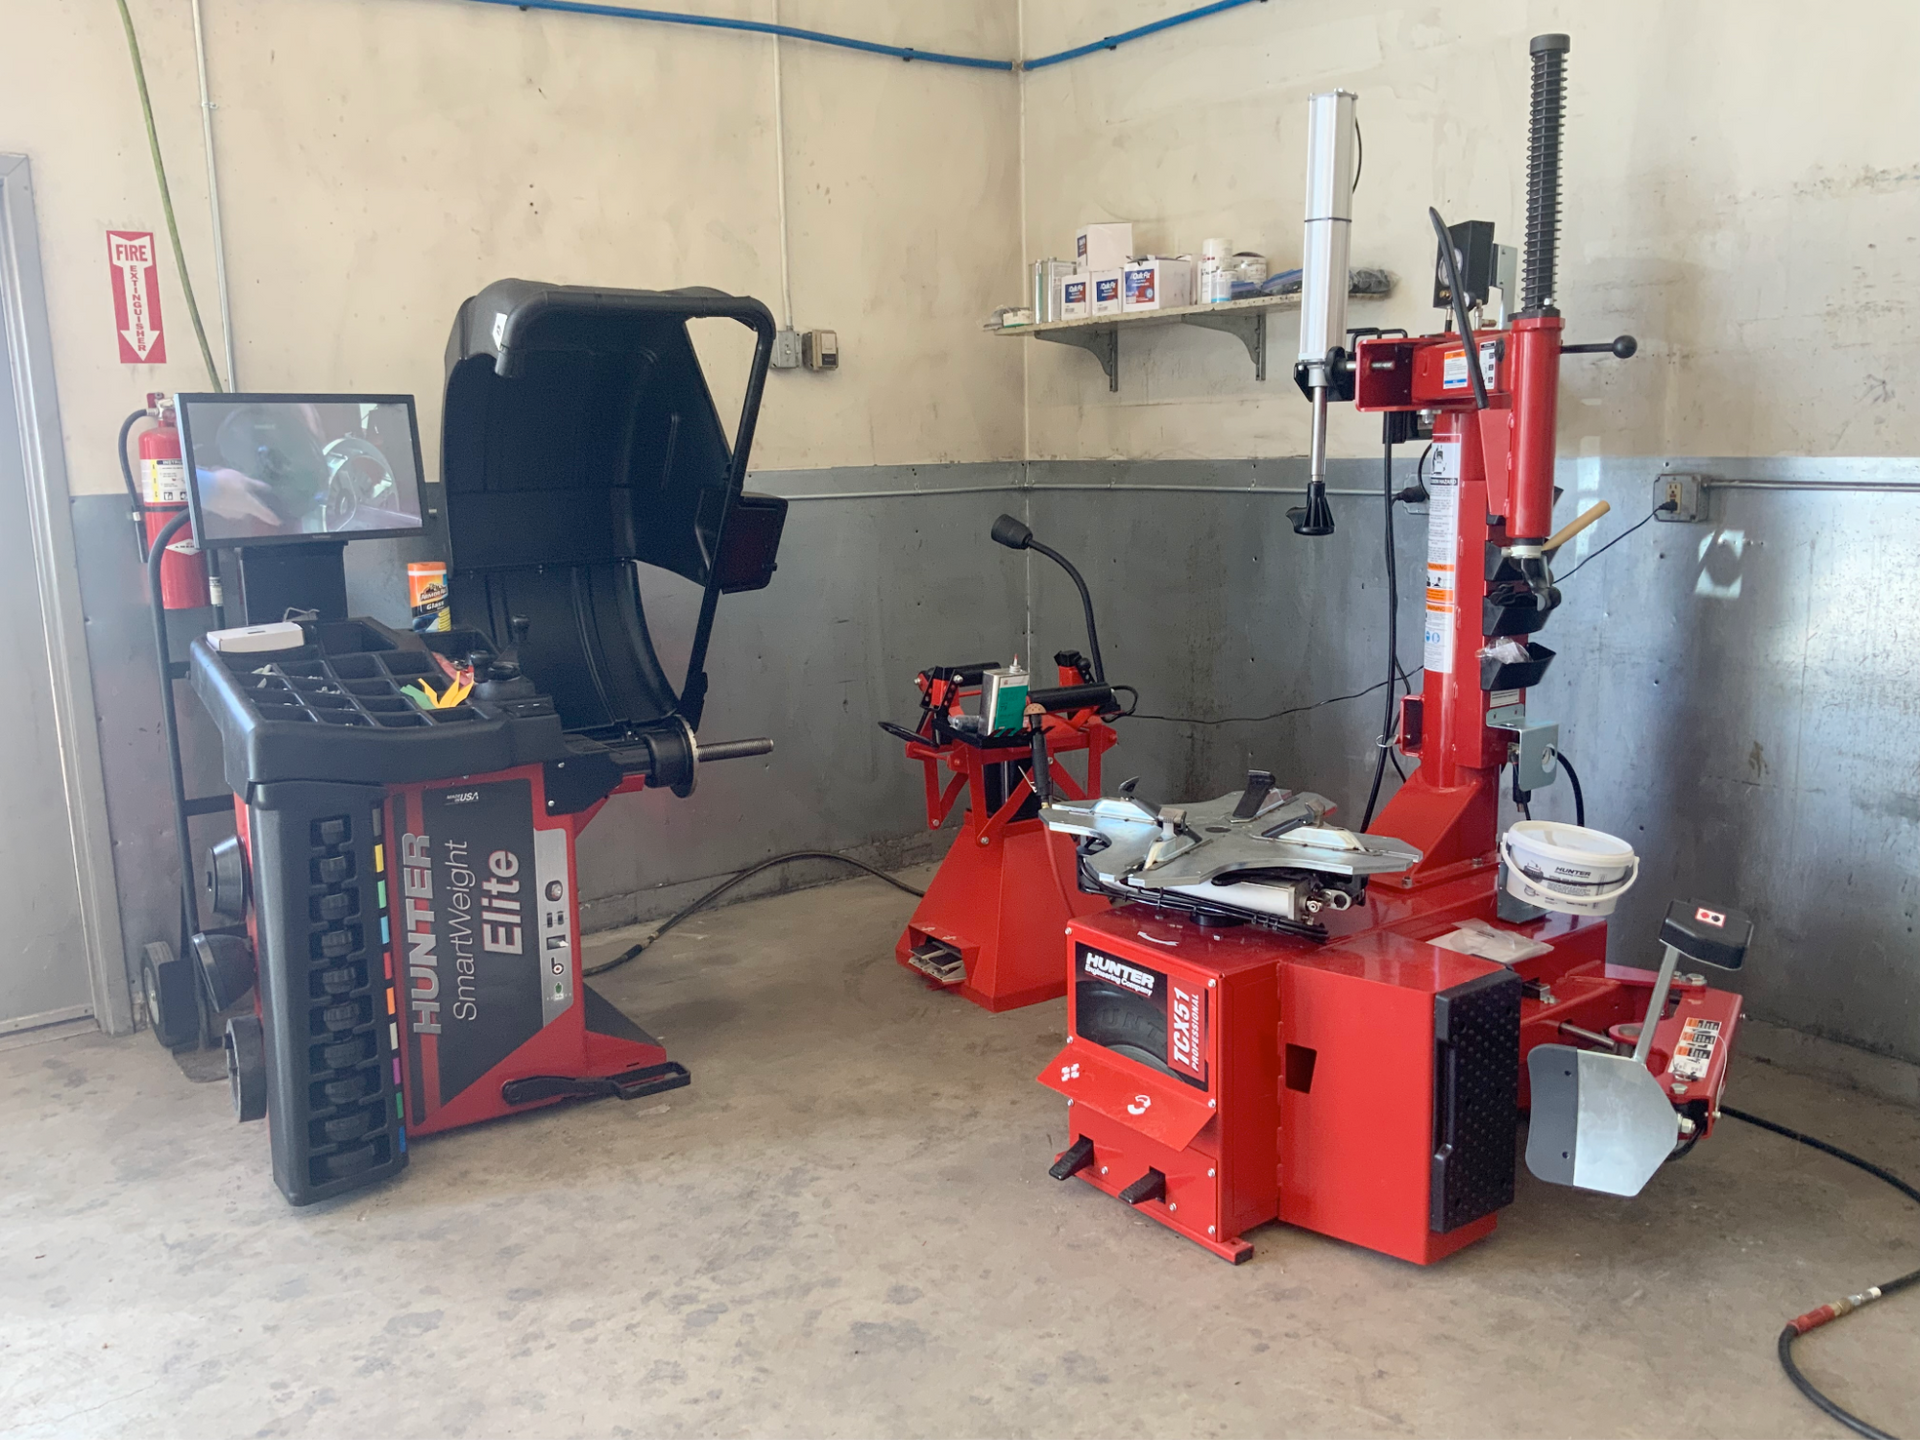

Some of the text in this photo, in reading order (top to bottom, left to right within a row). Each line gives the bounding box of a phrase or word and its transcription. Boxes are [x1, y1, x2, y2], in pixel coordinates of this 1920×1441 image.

[115, 243, 148, 262] FIRE
[129, 265, 147, 351] EXTINGUISHER
[460, 791, 479, 802] USA
[481, 850, 523, 955] Elite
[1555, 866, 1591, 877] HUNTER
[402, 833, 442, 1034] HUNTER
[444, 840, 477, 1020] SmartWeight
[1085, 963, 1153, 996] Engineering Company
[1086, 952, 1155, 989] HUNTER
[1173, 986, 1190, 1066] TCX51
[1191, 993, 1199, 1072] PROFESSIONAL
